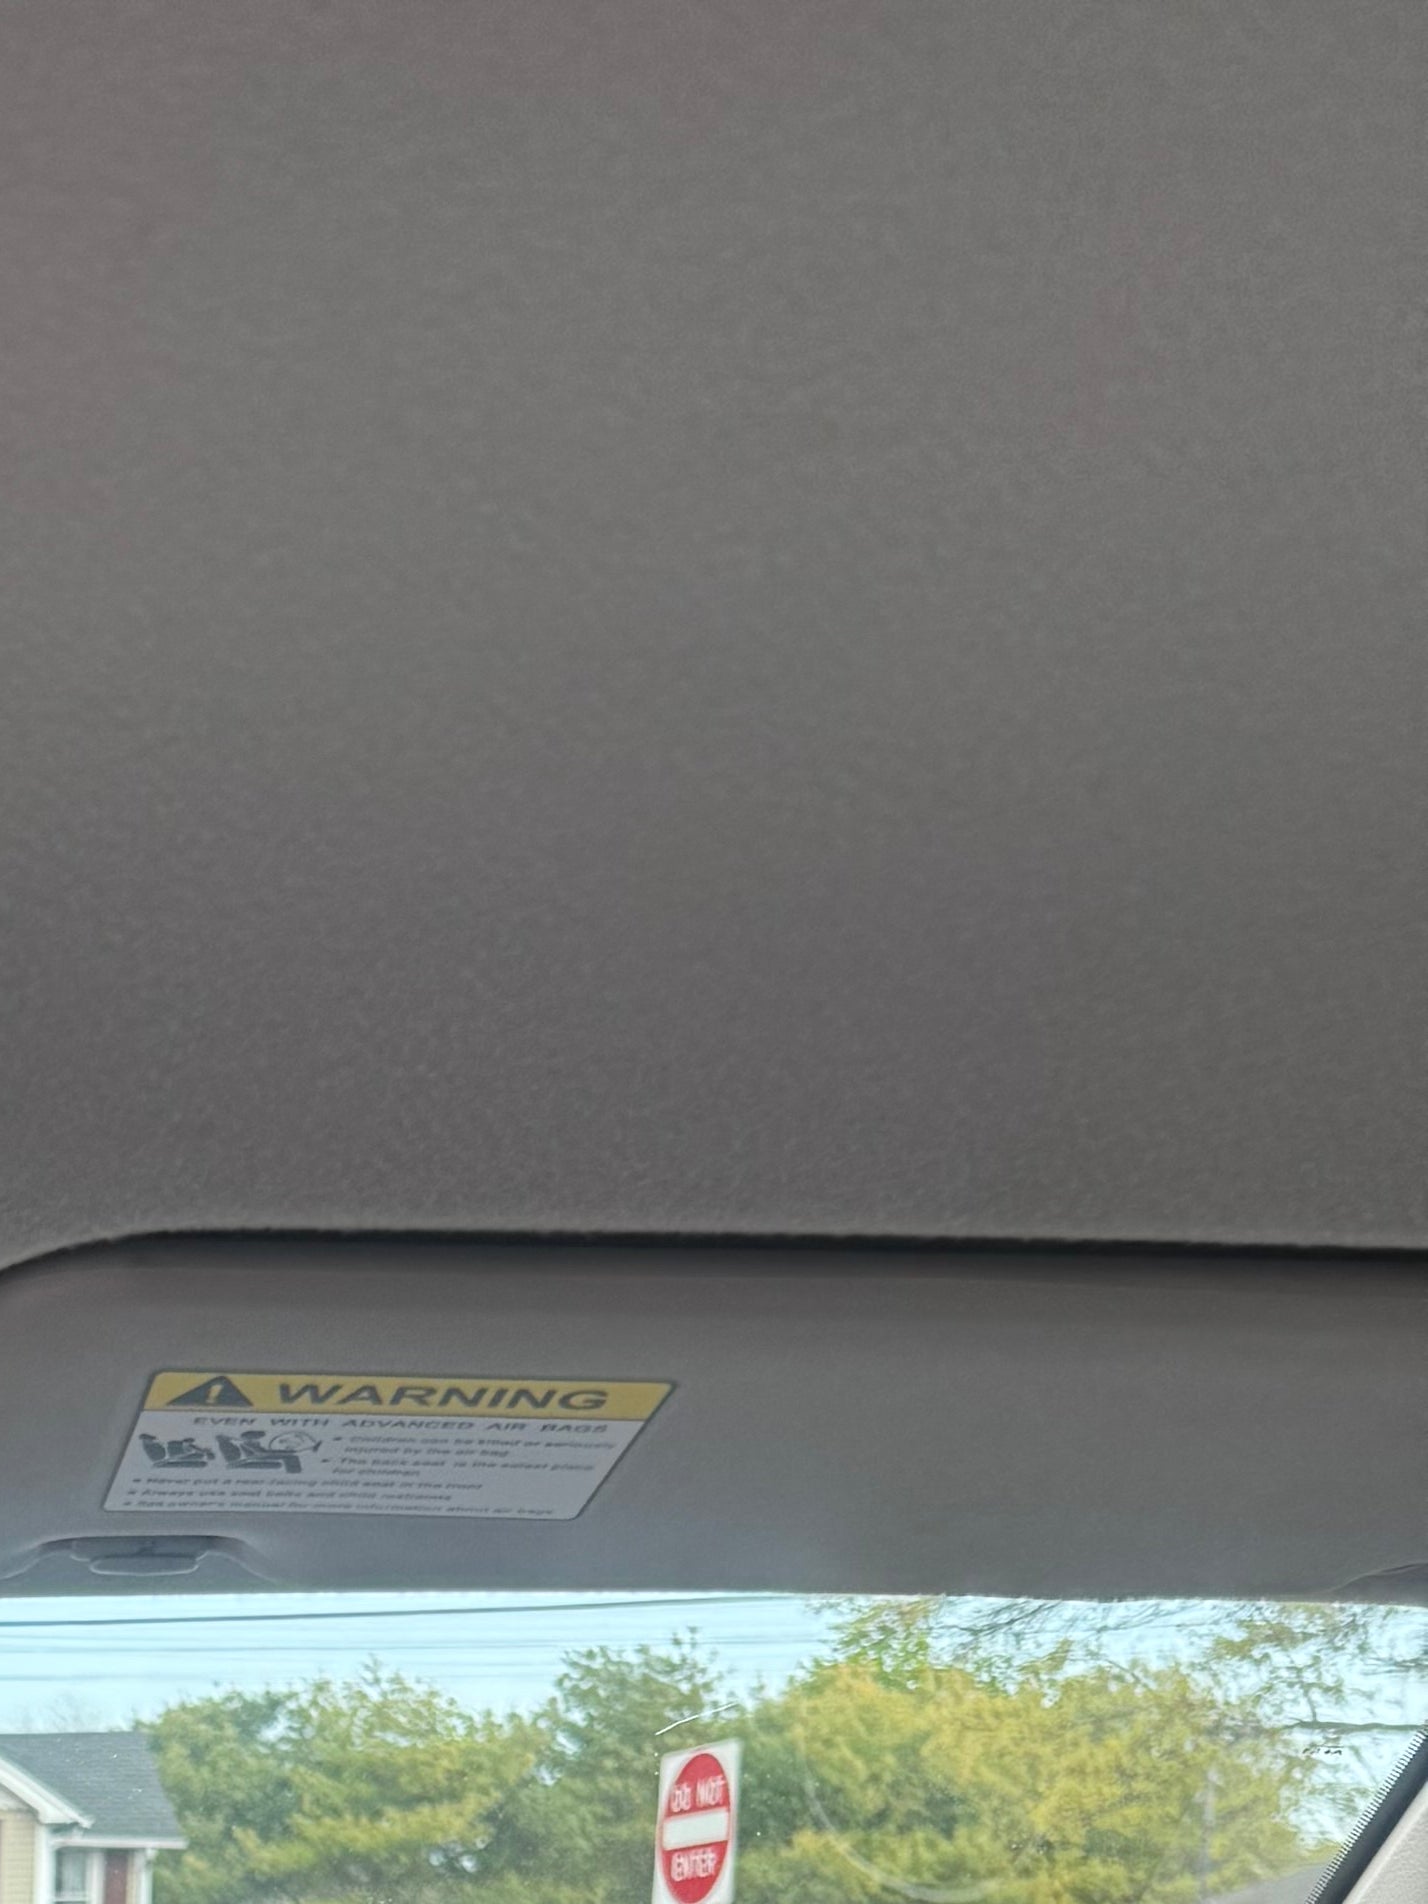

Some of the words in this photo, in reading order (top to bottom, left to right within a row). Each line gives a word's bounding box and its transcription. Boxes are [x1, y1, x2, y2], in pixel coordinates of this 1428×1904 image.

[278, 1383, 608, 1410] WARNING
[193, 1417, 256, 1426] EVEN
[270, 1418, 329, 1427] WITH
[343, 1419, 475, 1430] ADVANCED
[485, 1422, 527, 1431] AIR
[540, 1423, 608, 1433] BAGS
[670, 1783, 692, 1812] DO
[696, 1775, 726, 1807] NOT
[671, 1850, 718, 1882] ENTER
